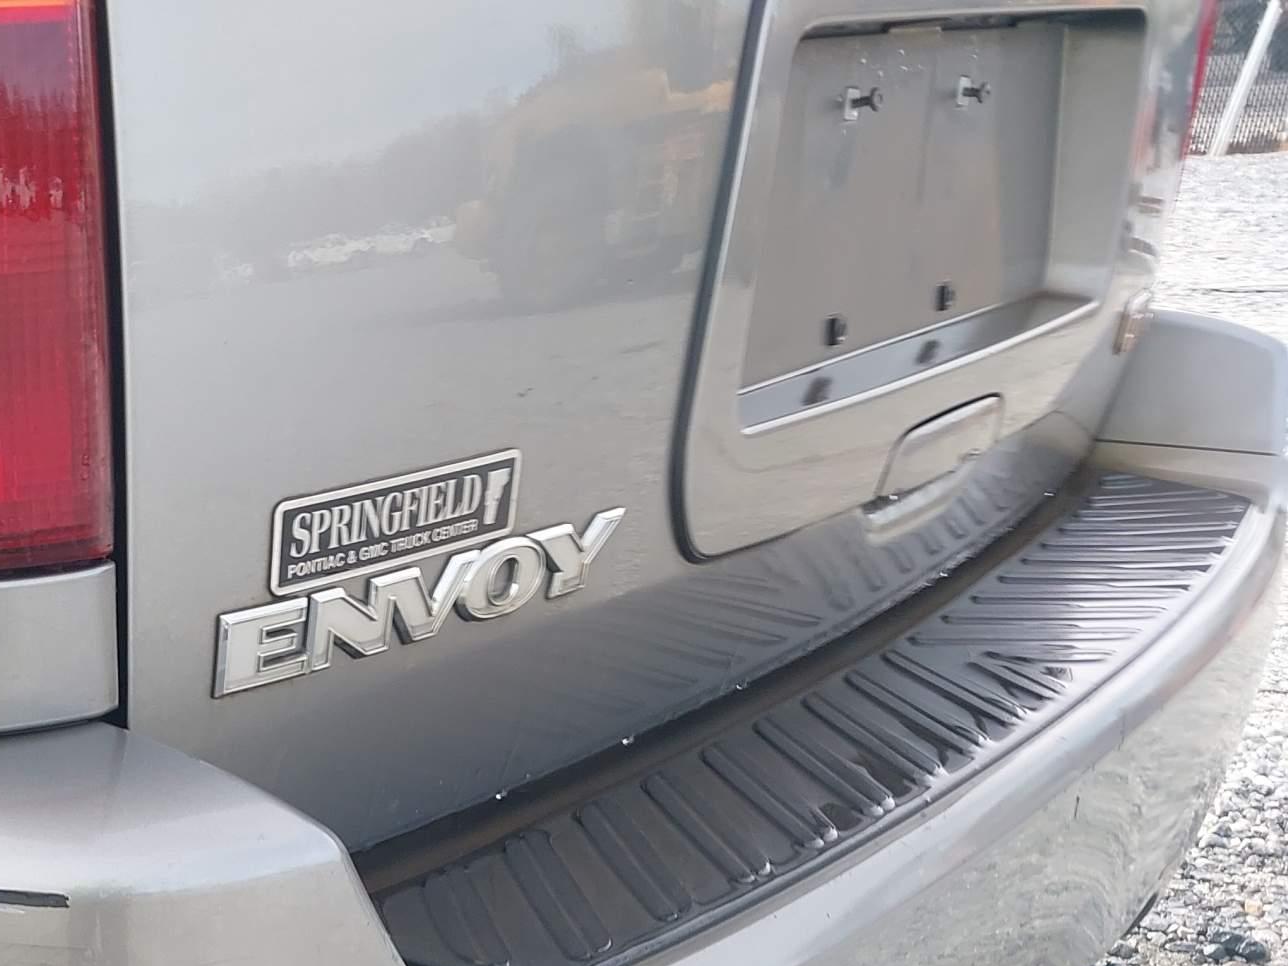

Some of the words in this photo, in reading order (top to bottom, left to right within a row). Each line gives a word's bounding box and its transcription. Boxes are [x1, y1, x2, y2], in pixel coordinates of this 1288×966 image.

[287, 552, 346, 580] PONTIAC
[346, 550, 358, 565] &
[359, 542, 390, 561] GMC
[390, 530, 432, 553] TRUCK
[431, 518, 479, 543] CENTER
[289, 473, 483, 558] SPRINGFIELD
[212, 507, 626, 699] ENVOY
